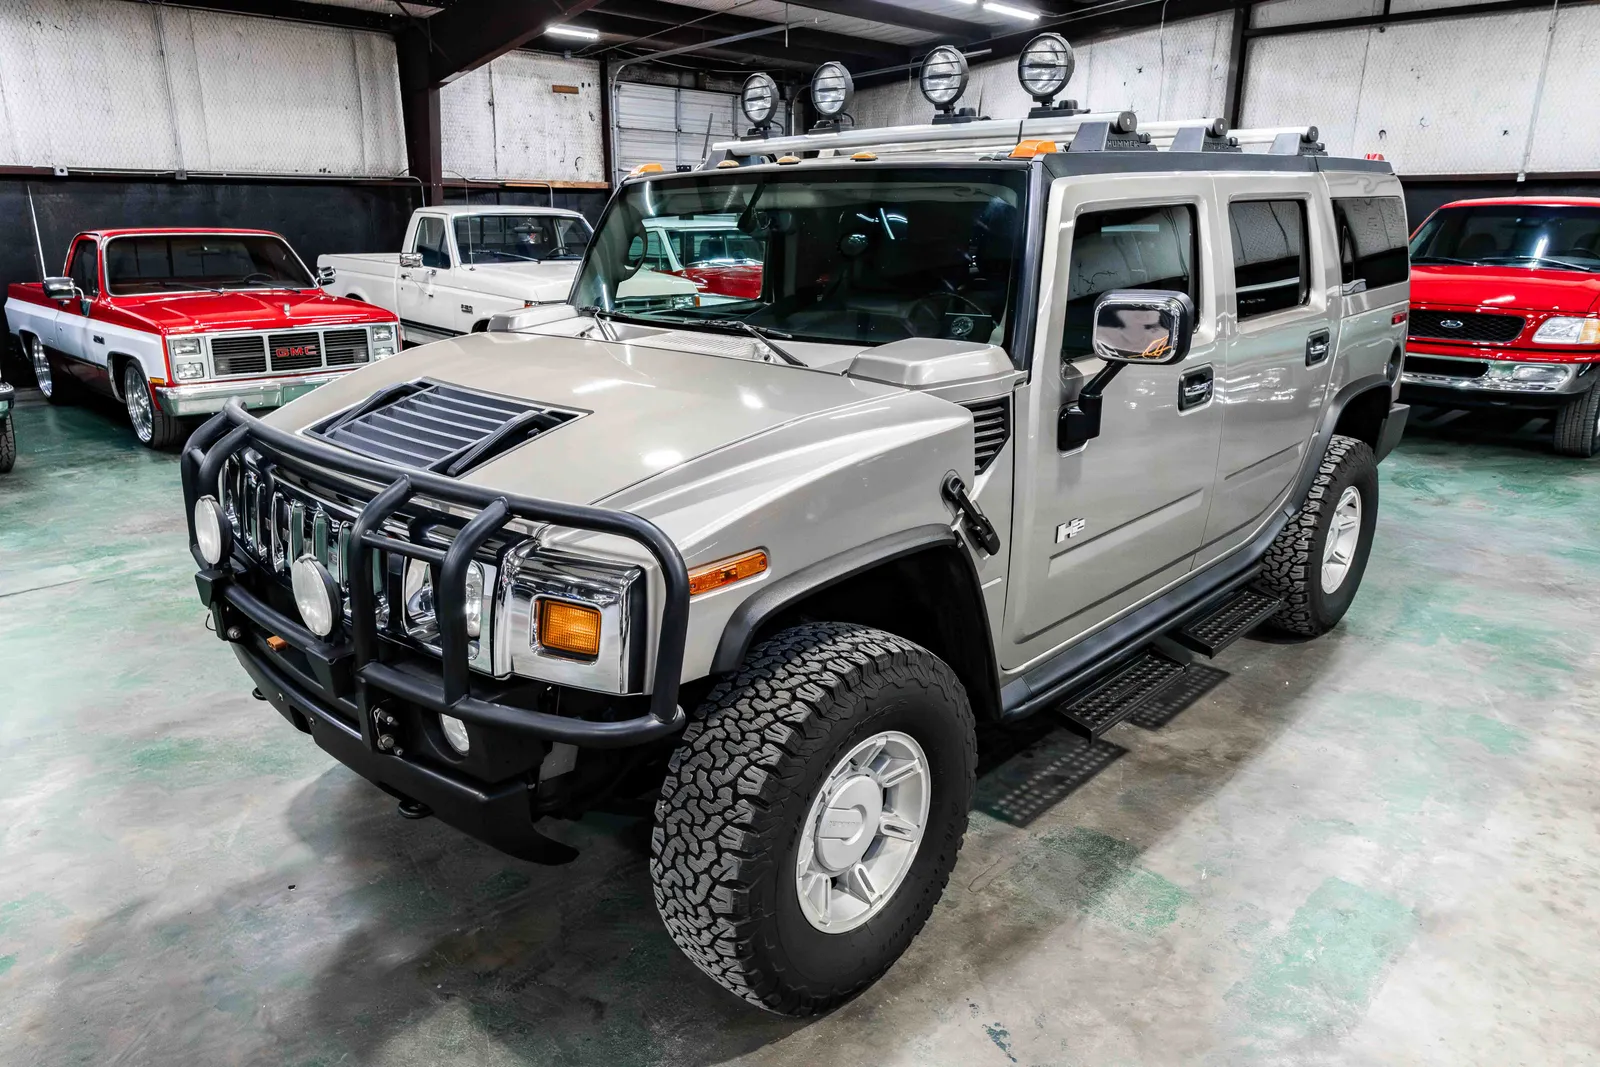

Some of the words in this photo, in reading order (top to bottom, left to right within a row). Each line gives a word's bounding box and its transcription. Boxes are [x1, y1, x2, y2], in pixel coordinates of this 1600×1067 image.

[1107, 140, 1140, 148] HUMMER
[275, 345, 317, 357] GMC
[1055, 518, 1086, 543] H2
